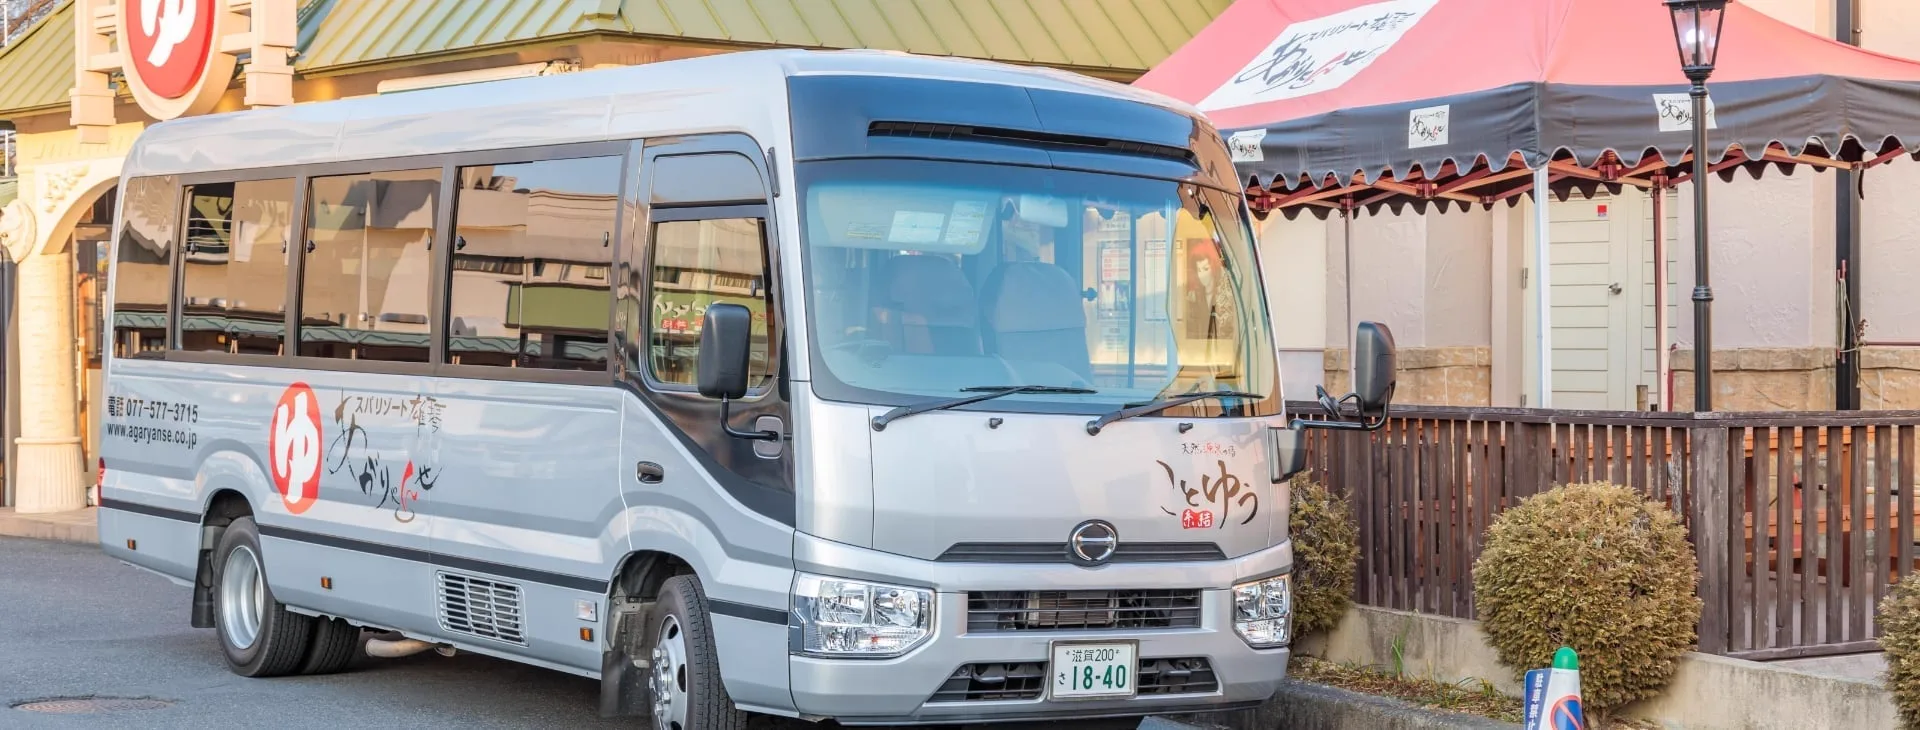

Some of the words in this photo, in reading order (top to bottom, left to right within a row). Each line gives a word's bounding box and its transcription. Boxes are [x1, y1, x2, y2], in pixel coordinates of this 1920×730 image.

[126, 398, 198, 423] 077-577-3715
[107, 423, 197, 450] www.agaryanse.co.jp
[275, 391, 319, 504] ゆ
[1156, 460, 1258, 529] ことゆう
[1058, 671, 1066, 685] さ
[1072, 664, 1127, 691] 18-40
